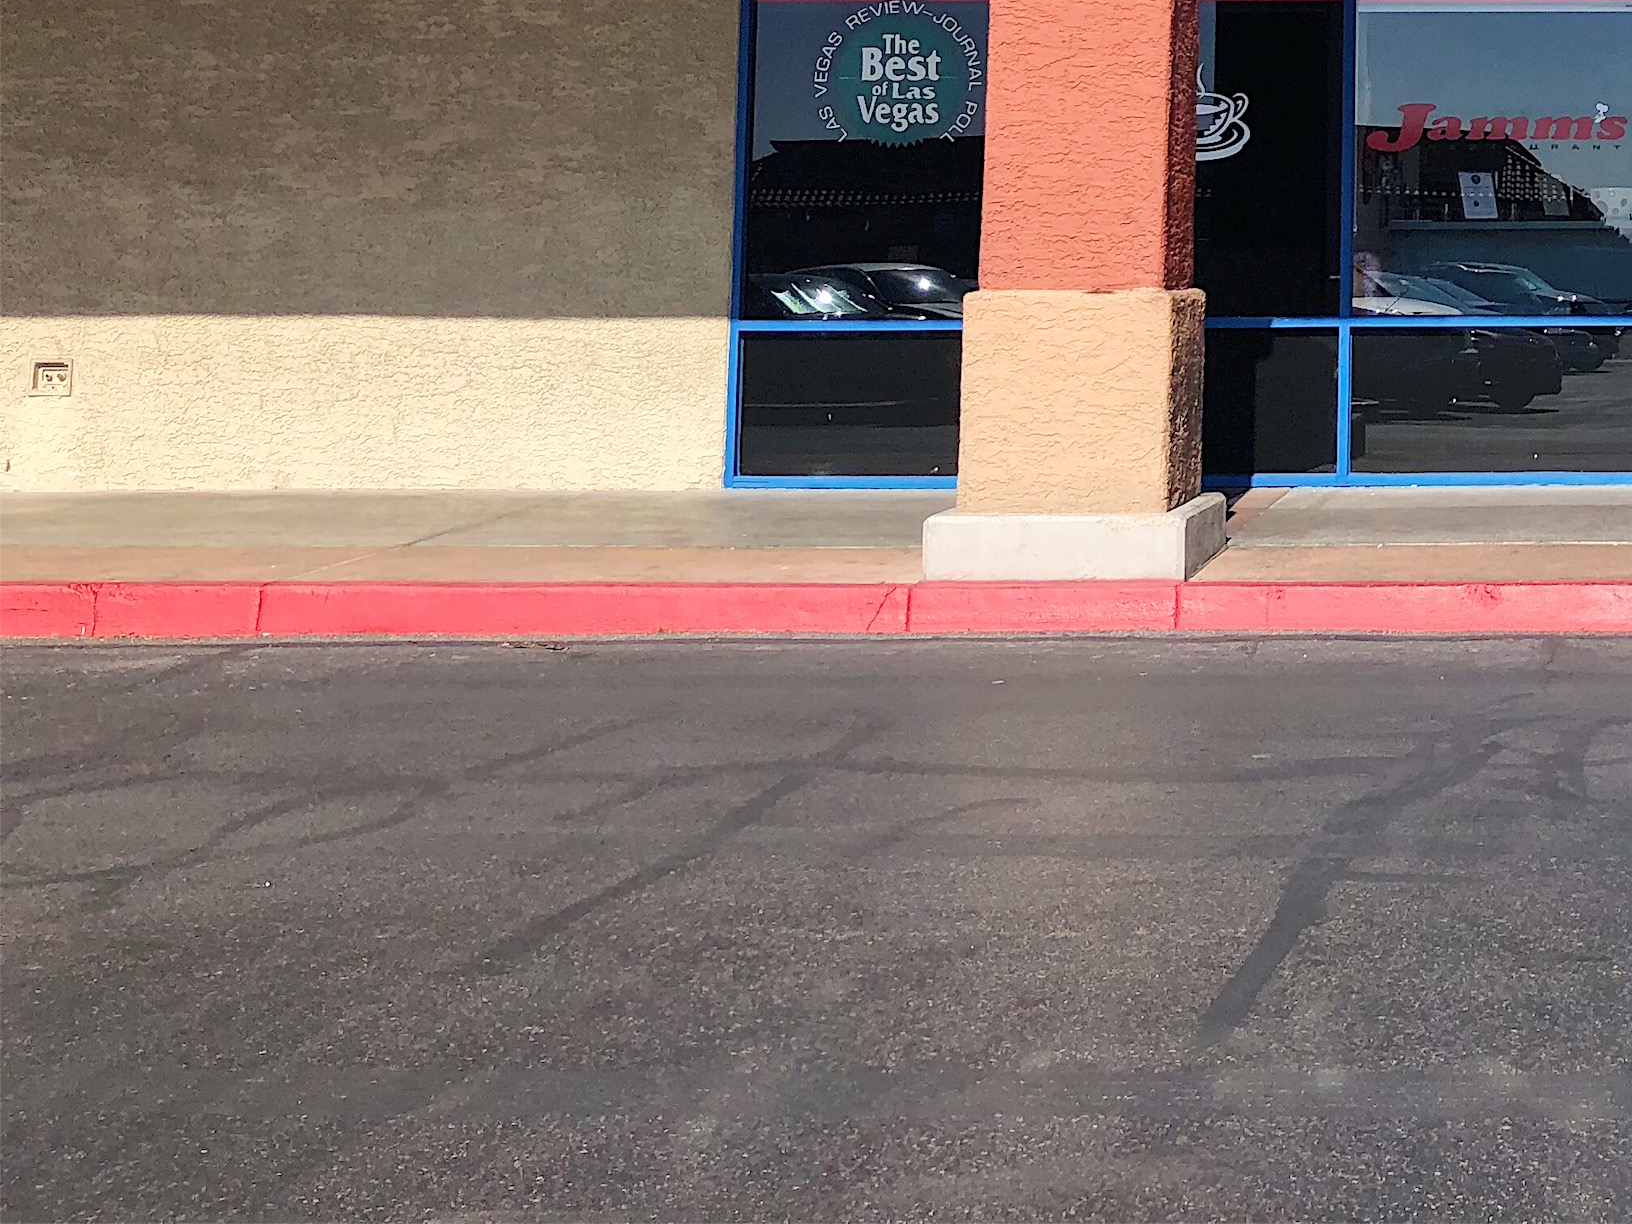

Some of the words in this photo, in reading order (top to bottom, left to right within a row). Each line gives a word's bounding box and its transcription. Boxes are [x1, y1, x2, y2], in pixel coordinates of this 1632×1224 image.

[845, 0, 983, 91] REVIEW-JOURNAL
[882, 33, 920, 55] The
[813, 31, 843, 98] VEGAS
[861, 46, 942, 81] Best
[872, 81, 889, 96] of
[892, 82, 936, 99] Las
[818, 106, 848, 142] LAS
[857, 95, 939, 133] Vegas
[939, 100, 978, 142] POLL
